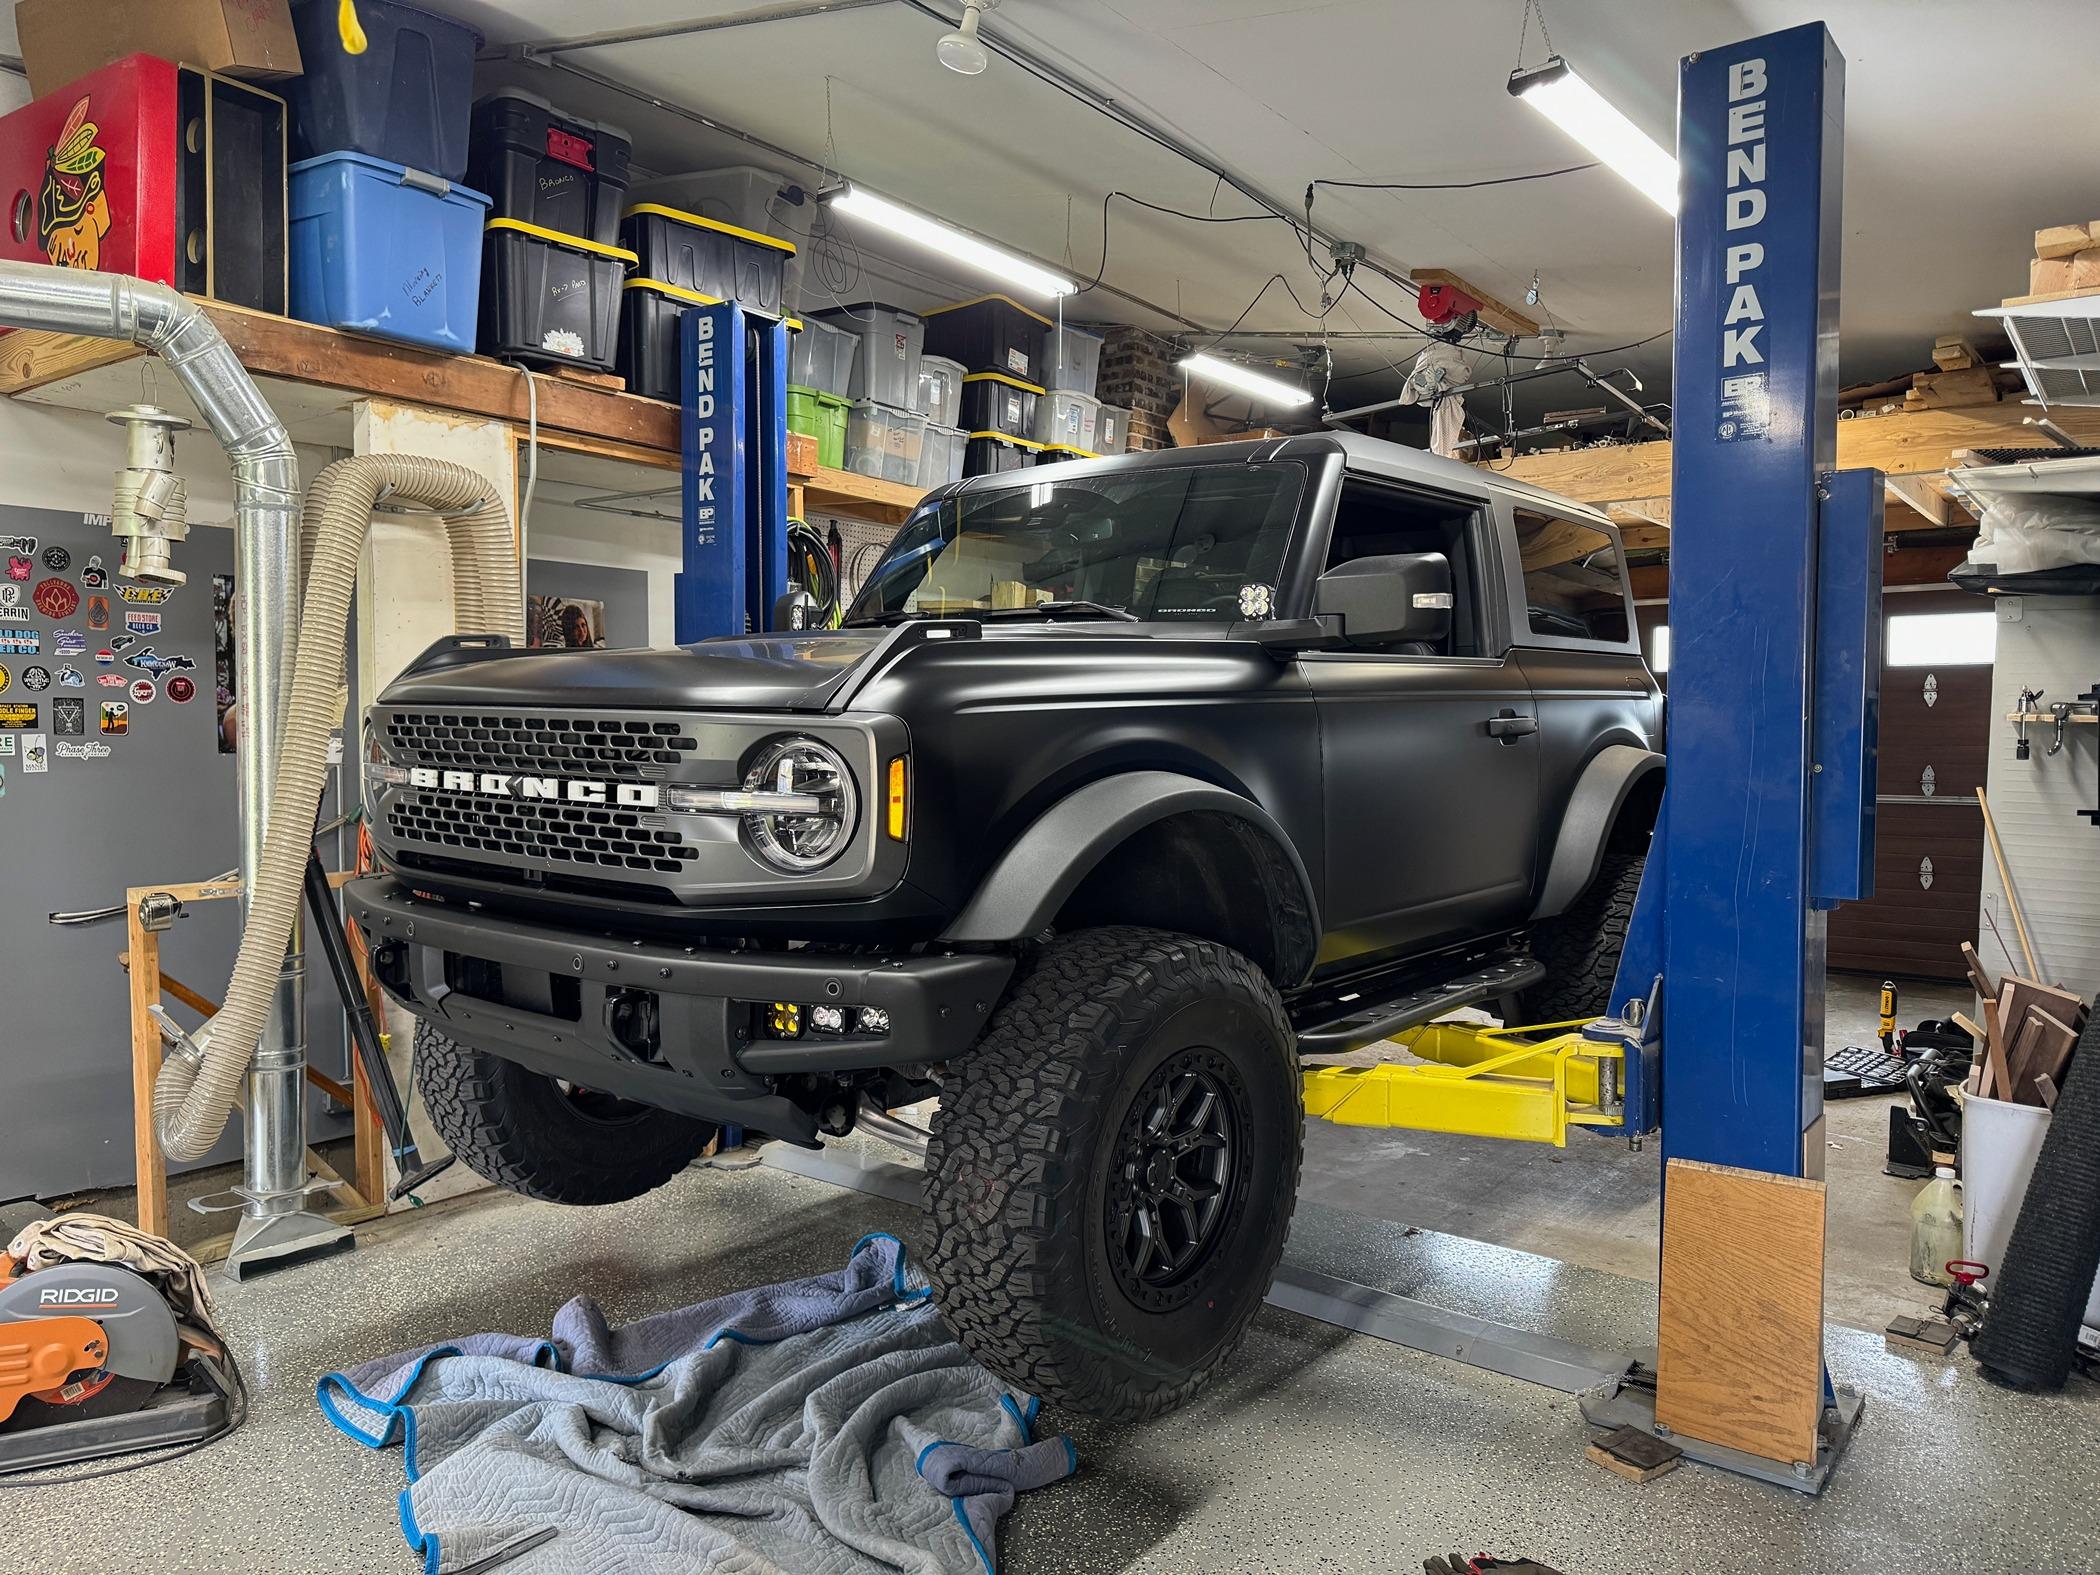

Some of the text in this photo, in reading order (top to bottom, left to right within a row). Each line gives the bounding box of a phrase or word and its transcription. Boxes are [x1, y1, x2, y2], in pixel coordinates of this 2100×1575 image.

[1726, 57, 1768, 232] BEND
[1723, 242, 1765, 368] PAK
[698, 316, 715, 419] BEND
[698, 427, 715, 501] PAK
[410, 767, 660, 808] BRONCO
[40, 1288, 119, 1304] RIDGID
